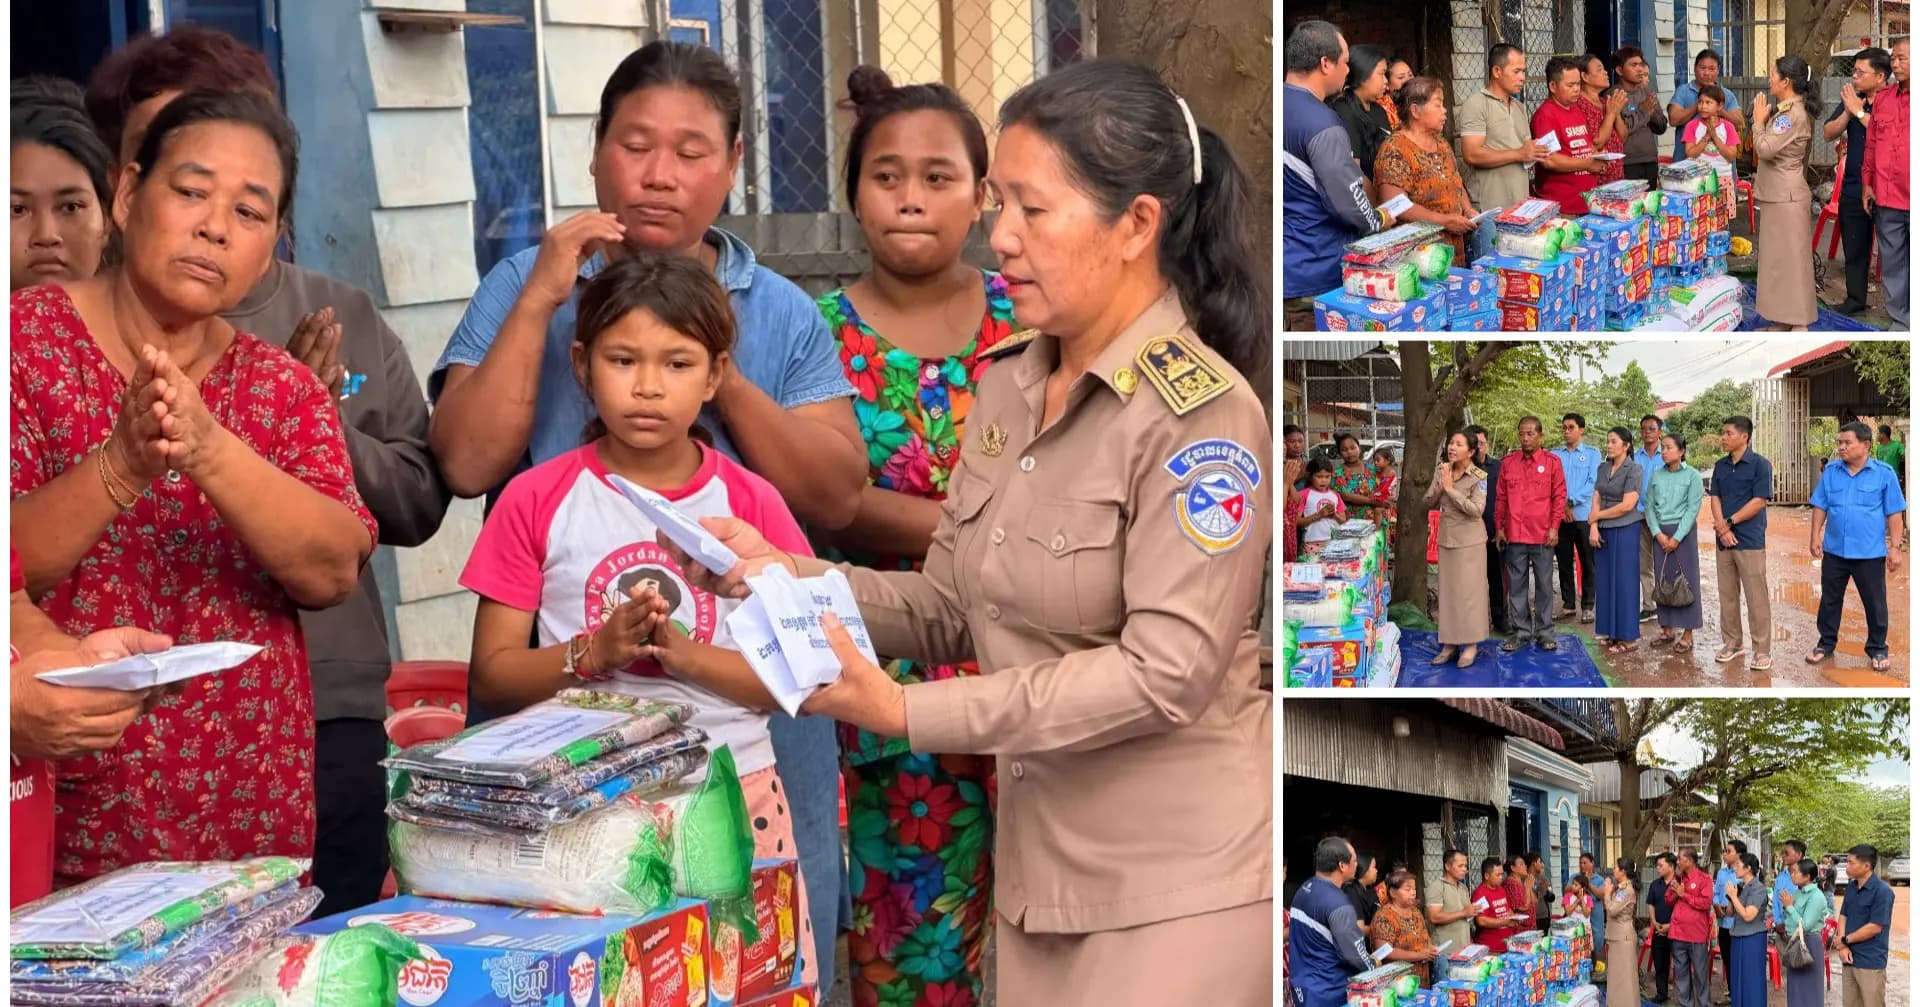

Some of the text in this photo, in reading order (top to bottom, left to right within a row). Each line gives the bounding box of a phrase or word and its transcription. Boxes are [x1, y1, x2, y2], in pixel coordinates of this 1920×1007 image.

[606, 547, 668, 574] Jordan
[588, 575, 605, 595] Pa
[588, 605, 600, 626] Pa
[10, 775, 33, 801] IOUS
